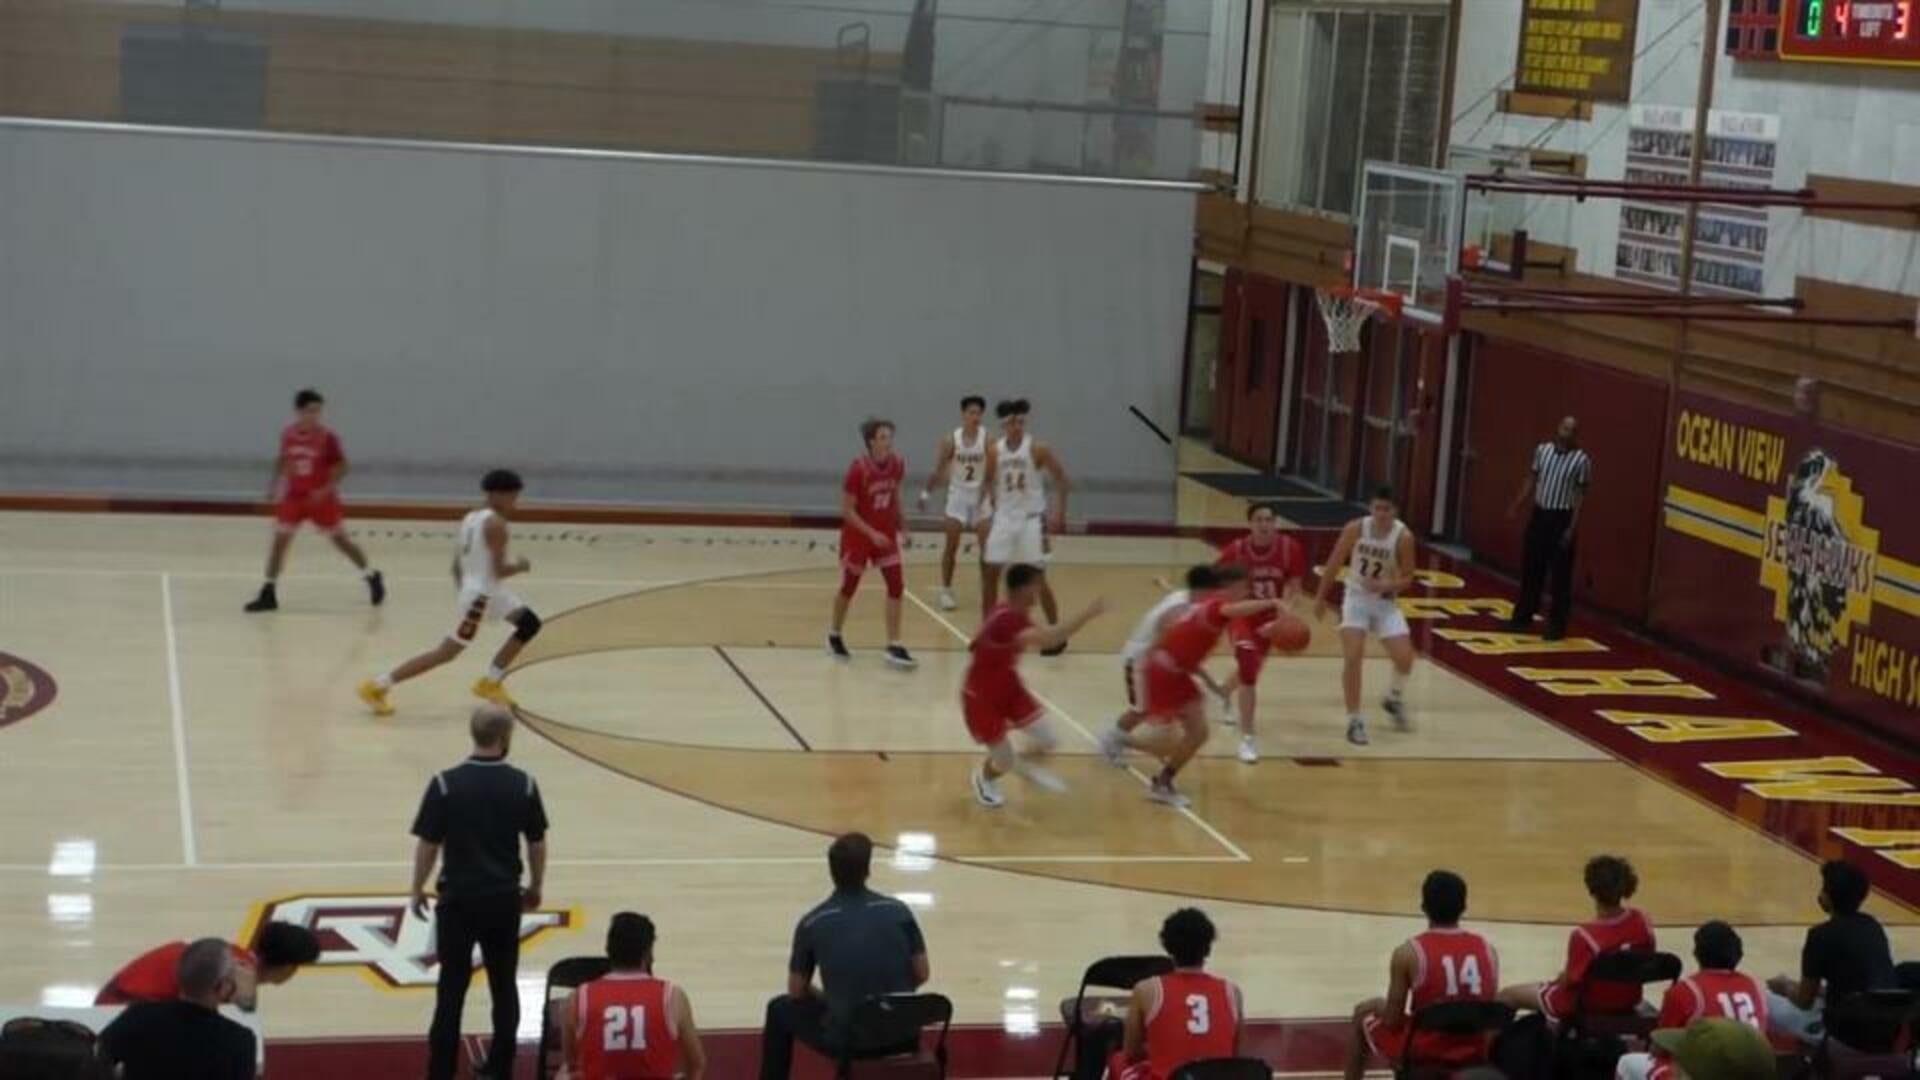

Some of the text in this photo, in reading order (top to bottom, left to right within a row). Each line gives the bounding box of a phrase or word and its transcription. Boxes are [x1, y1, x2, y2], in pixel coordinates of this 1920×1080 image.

[1677, 409, 1784, 484] OCEAN VIEW
[964, 465, 976, 481] 2
[1359, 557, 1384, 579] 22
[1765, 519, 1871, 593] SEAHAWKS
[1850, 632, 1906, 701] HIGH
[1441, 955, 1482, 995] 14
[603, 1005, 647, 1051] 21
[1185, 993, 1210, 1035] 3
